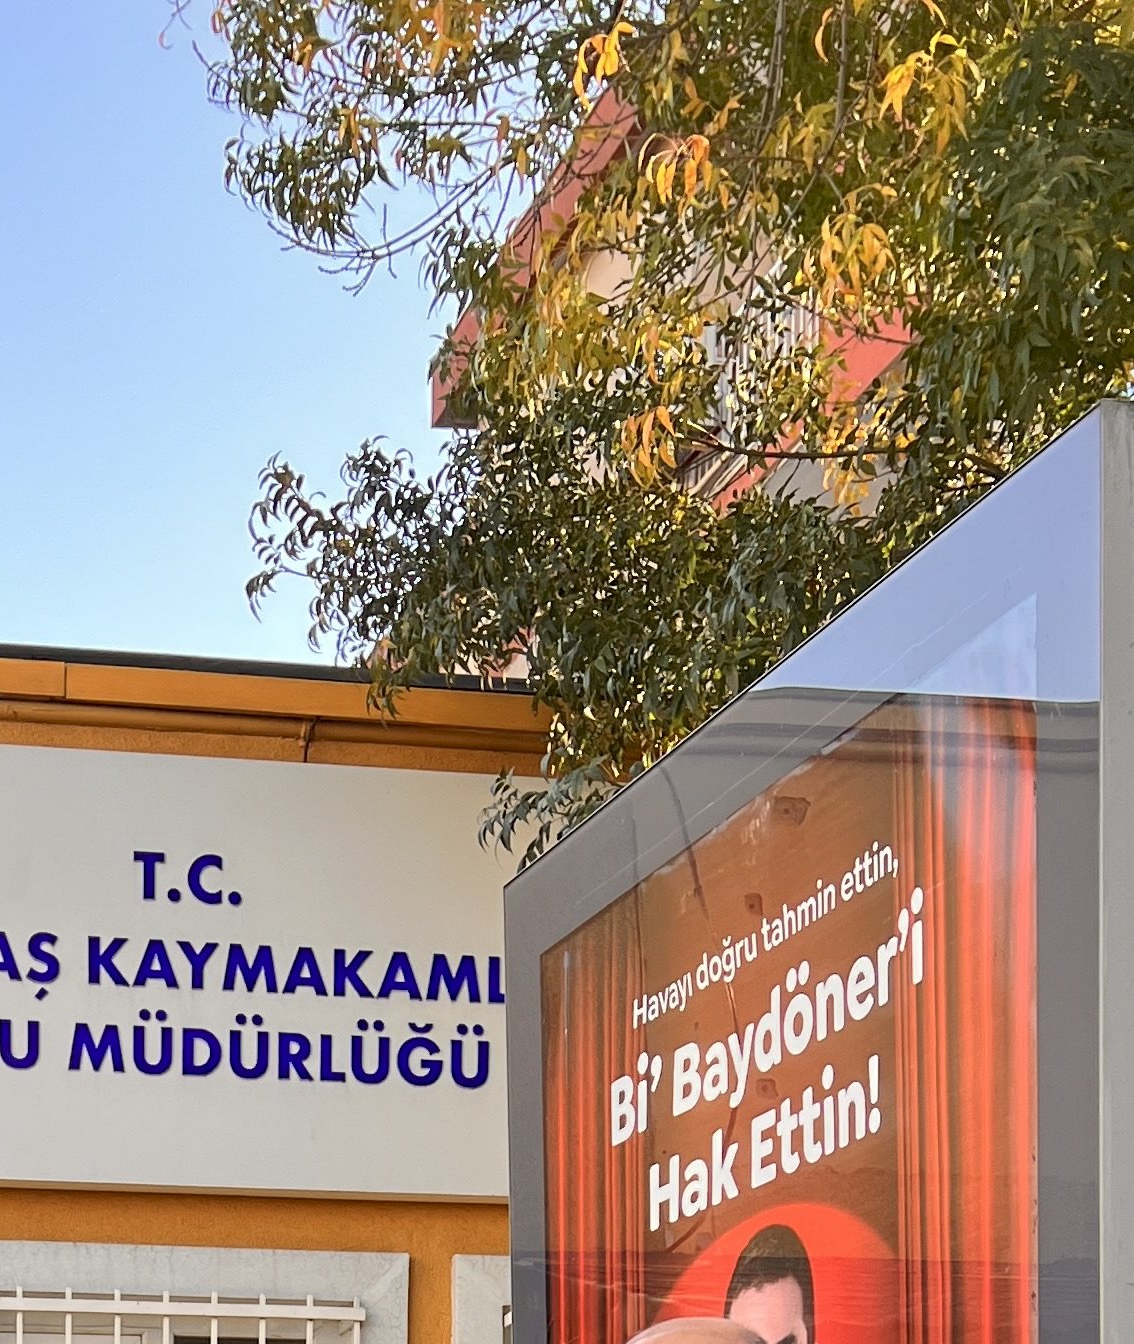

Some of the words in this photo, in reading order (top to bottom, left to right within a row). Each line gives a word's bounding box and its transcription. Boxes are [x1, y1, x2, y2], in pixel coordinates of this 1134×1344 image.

[133, 851, 242, 906] T.C.
[87, 935, 505, 1004] KAYMAKAML
[632, 971, 693, 1029] Havayı
[695, 933, 758, 990] doğru
[761, 879, 836, 951] tahmin
[840, 841, 899, 901] ettin,
[68, 1008, 490, 1089] MÜDÜRLÜĞÜ
[649, 1128, 739, 1232] Hak
[750, 1054, 881, 1189] Ettin!
